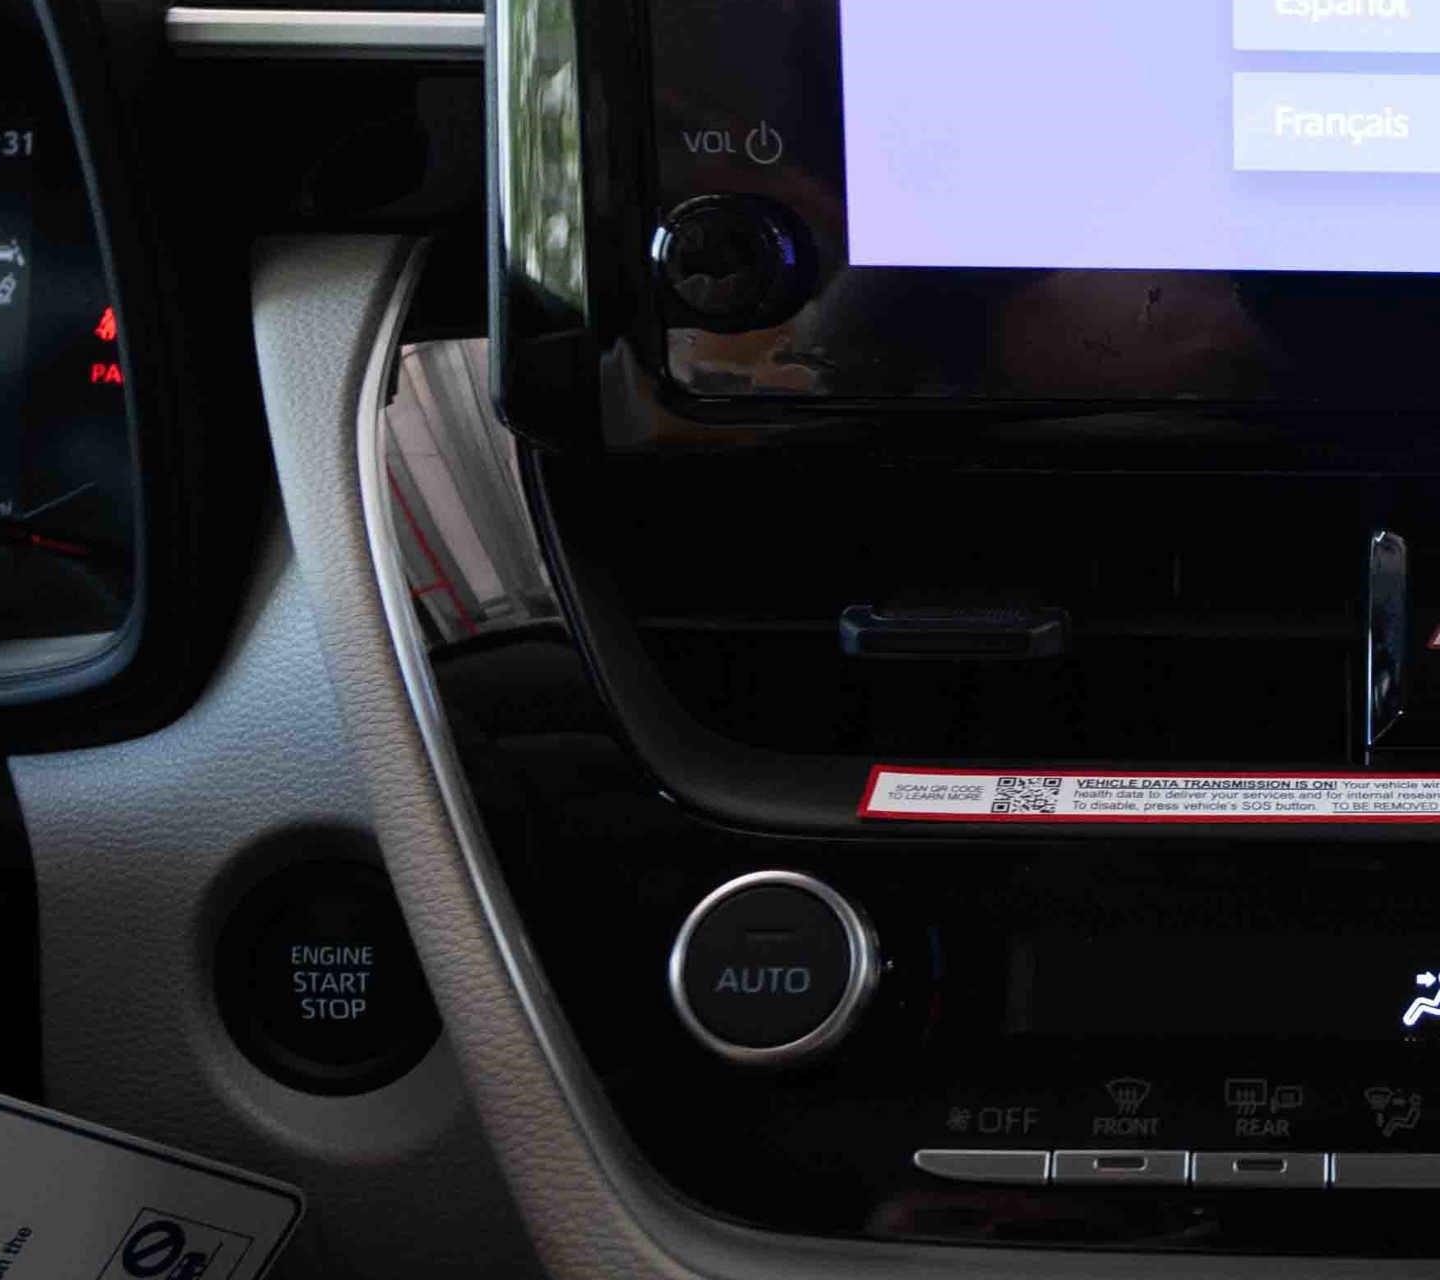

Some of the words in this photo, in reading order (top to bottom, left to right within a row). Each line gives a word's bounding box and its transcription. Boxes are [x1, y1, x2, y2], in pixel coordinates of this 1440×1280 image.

[1272, 105, 1410, 146] Français
[682, 130, 736, 154] VOL
[1076, 779, 1139, 790] VEHICLE
[1143, 779, 1178, 790] DATA
[1184, 779, 1291, 791] TRANSMISSION
[1295, 780, 1308, 791] IS
[1312, 780, 1338, 791] ON!
[1072, 801, 1086, 810] To
[1143, 802, 1180, 813] press
[1241, 802, 1273, 811] SOS
[291, 946, 372, 966] ENGINE
[293, 971, 370, 993] START
[716, 966, 811, 994] AUTO
[301, 998, 366, 1019] STOP
[978, 1107, 1037, 1134] OFF
[1093, 1117, 1159, 1135] FRONT
[1235, 1117, 1290, 1136] REAR
[1, 1226, 33, 1255] the
